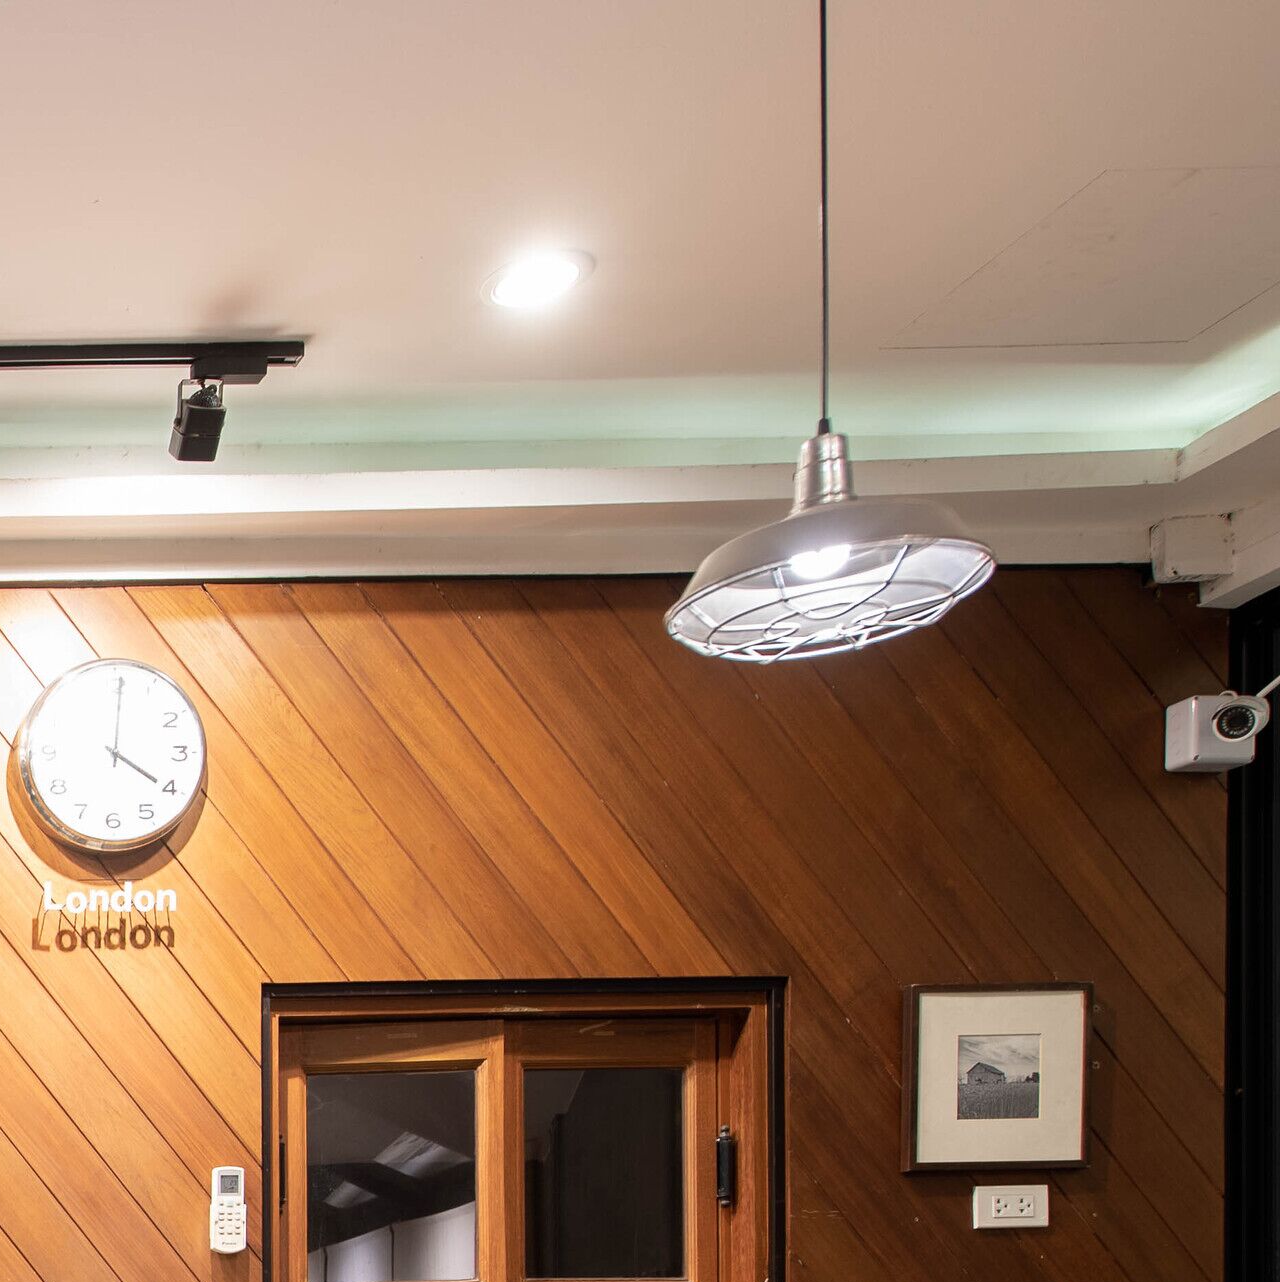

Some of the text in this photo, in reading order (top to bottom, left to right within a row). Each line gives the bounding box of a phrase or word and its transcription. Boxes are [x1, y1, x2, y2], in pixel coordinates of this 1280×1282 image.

[162, 712, 178, 728] 2
[171, 746, 188, 762] 3
[50, 779, 67, 795] 8
[162, 780, 177, 796] 4
[74, 804, 88, 820] 7
[138, 804, 155, 820] 5
[106, 813, 121, 829] 6
[42, 880, 178, 914] London
